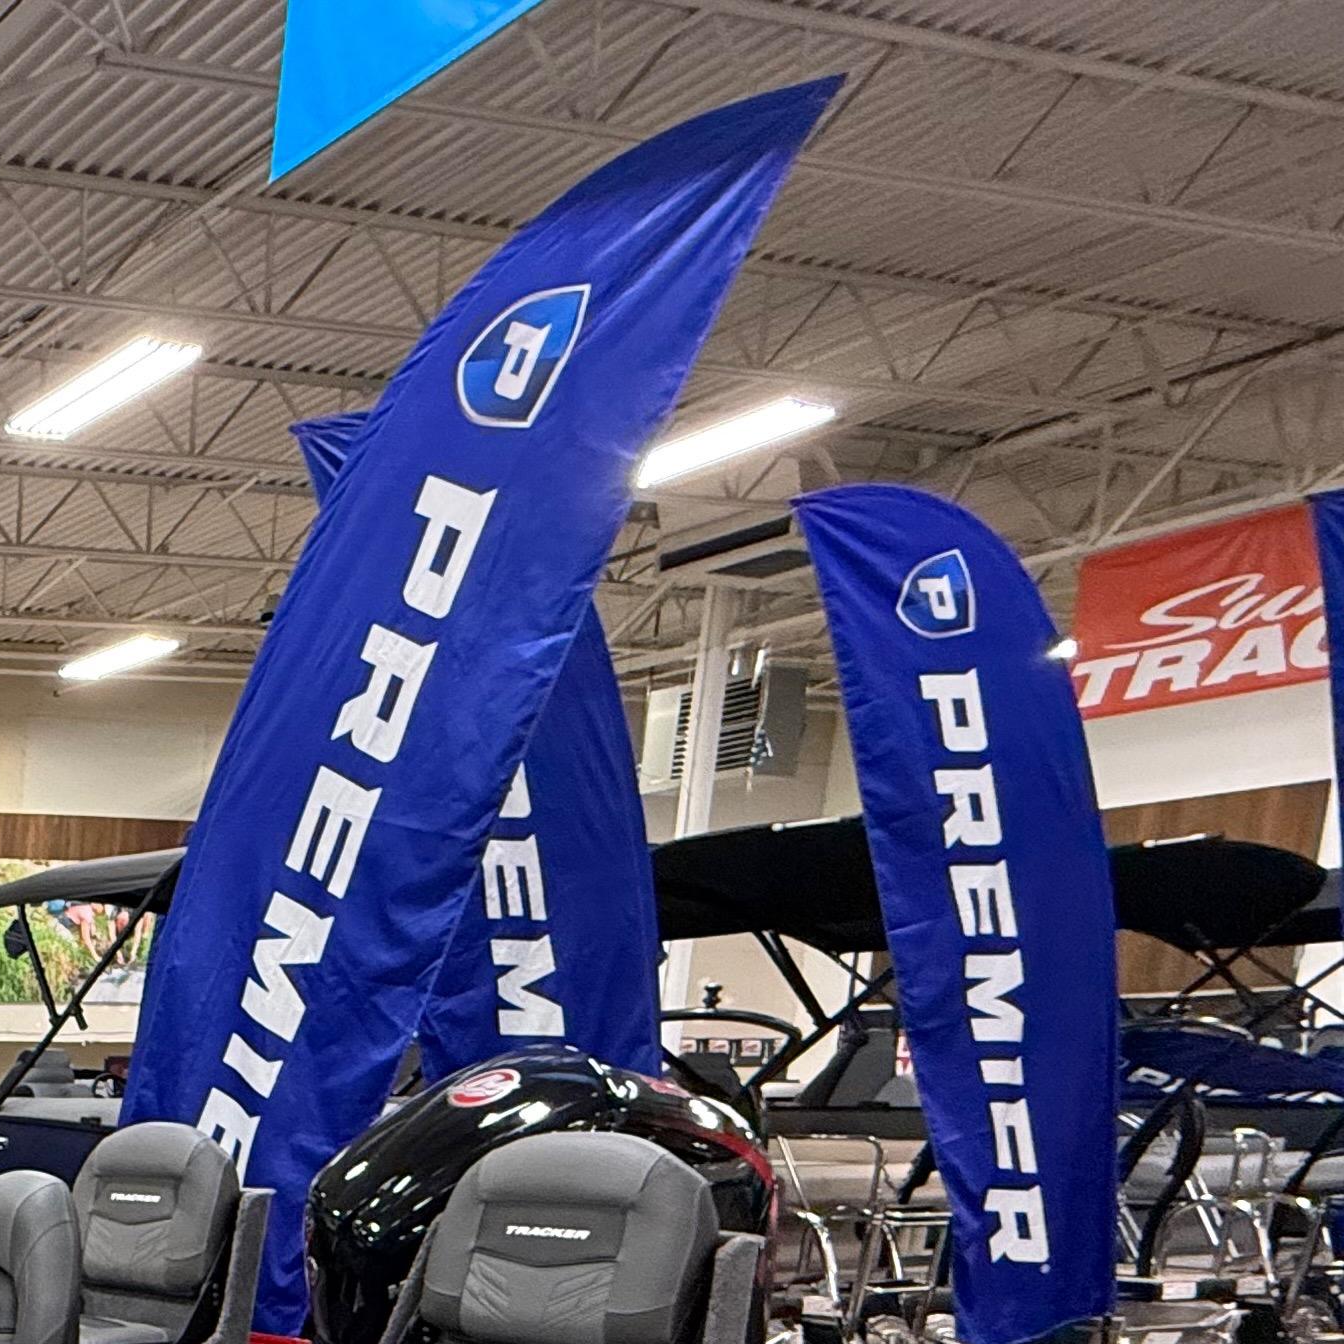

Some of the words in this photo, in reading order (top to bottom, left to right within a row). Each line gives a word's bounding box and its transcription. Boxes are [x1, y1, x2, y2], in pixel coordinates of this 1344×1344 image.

[196, 474, 498, 1190] PREMIE
[1071, 622, 1330, 708] TRAC
[919, 667, 1051, 1266] PREMIER
[505, 1224, 591, 1241] TRACKER
